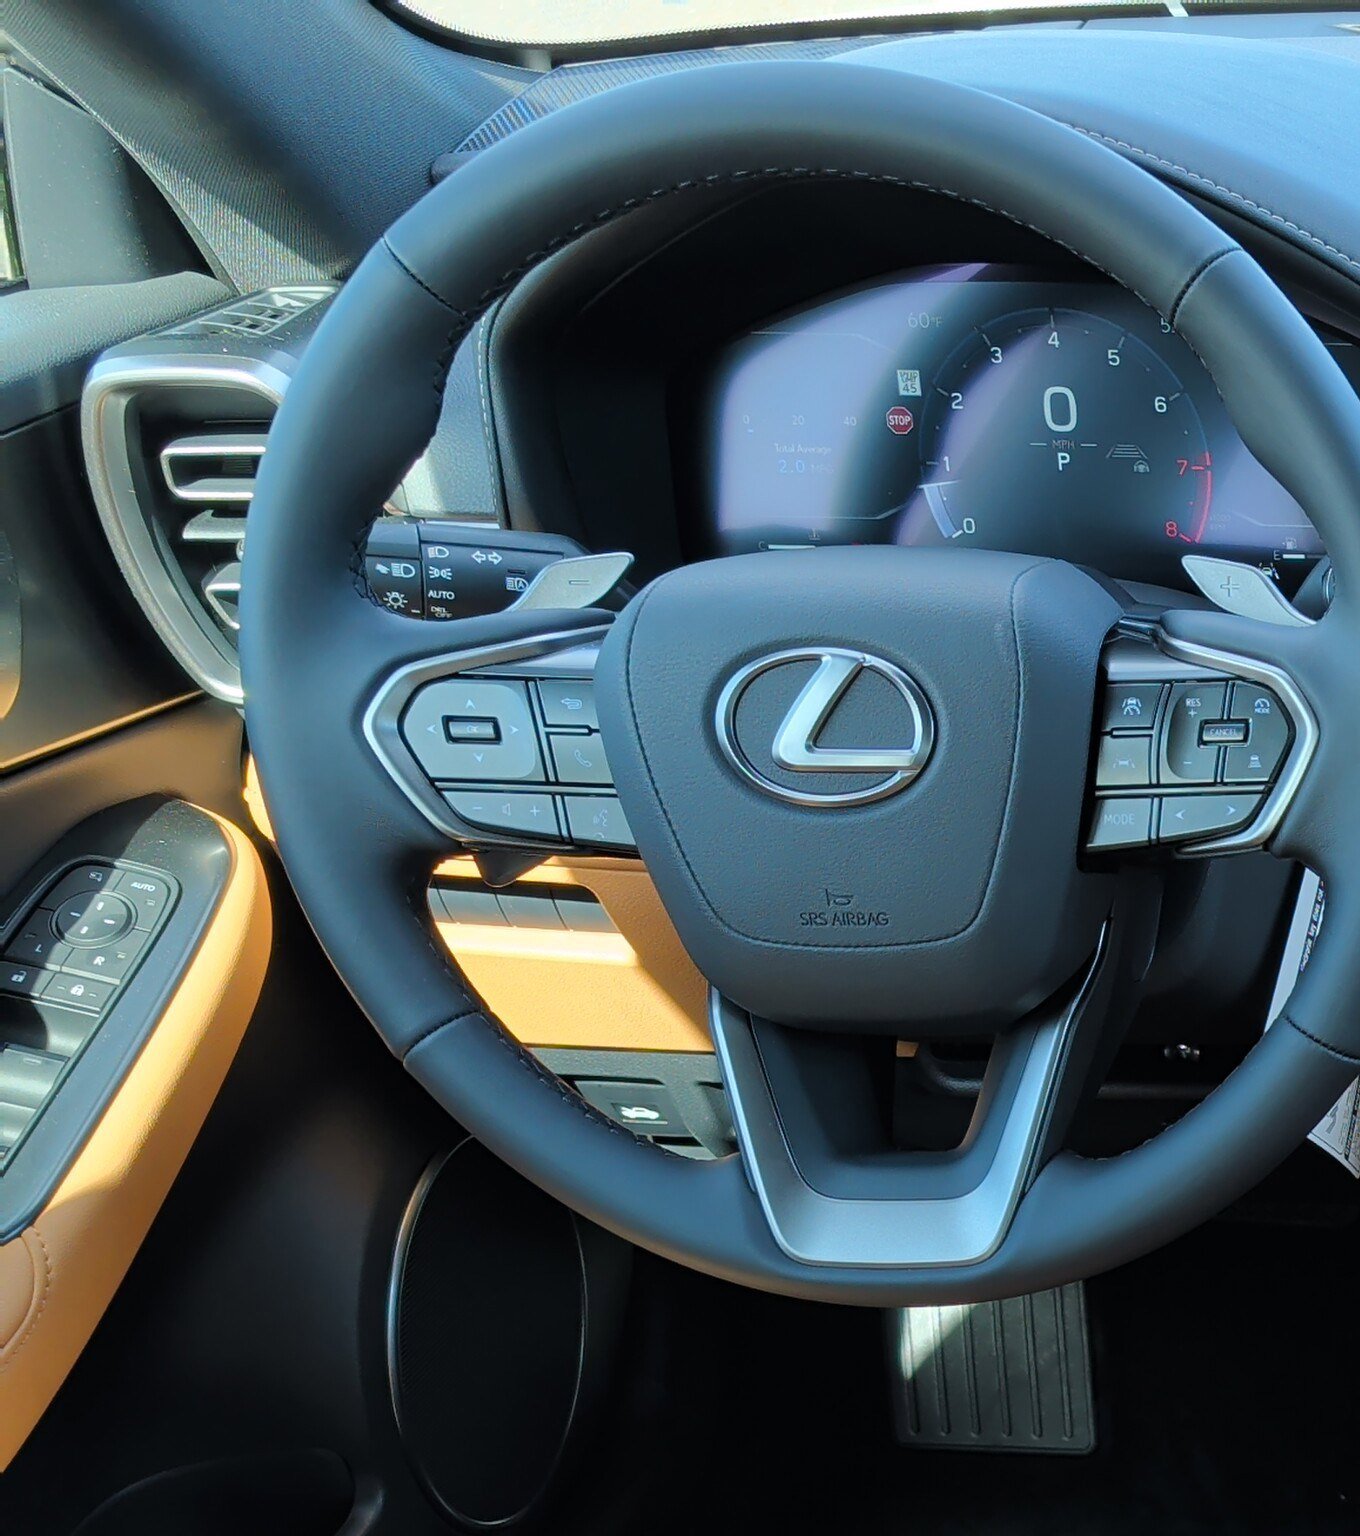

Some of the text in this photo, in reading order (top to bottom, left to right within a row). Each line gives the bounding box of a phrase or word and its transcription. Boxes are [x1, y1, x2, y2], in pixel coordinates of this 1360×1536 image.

[1048, 331, 1060, 349] 4
[990, 346, 1003, 364] 3
[1107, 349, 1120, 366] 5
[950, 392, 964, 410] 2
[1153, 396, 1168, 413] 6
[1043, 386, 1078, 433] 0
[888, 414, 911, 426] STOP
[1052, 439, 1076, 450] MPH
[942, 456, 951, 472] 1
[1057, 453, 1071, 471] P
[1177, 460, 1189, 476] 7
[963, 518, 976, 534] 0
[1165, 521, 1178, 538] 8
[428, 590, 455, 600] AUTO
[1185, 698, 1201, 707] RES
[1104, 814, 1135, 825] MODE
[130, 881, 156, 892] AUTO
[799, 911, 890, 926] SRS AIRBAG
